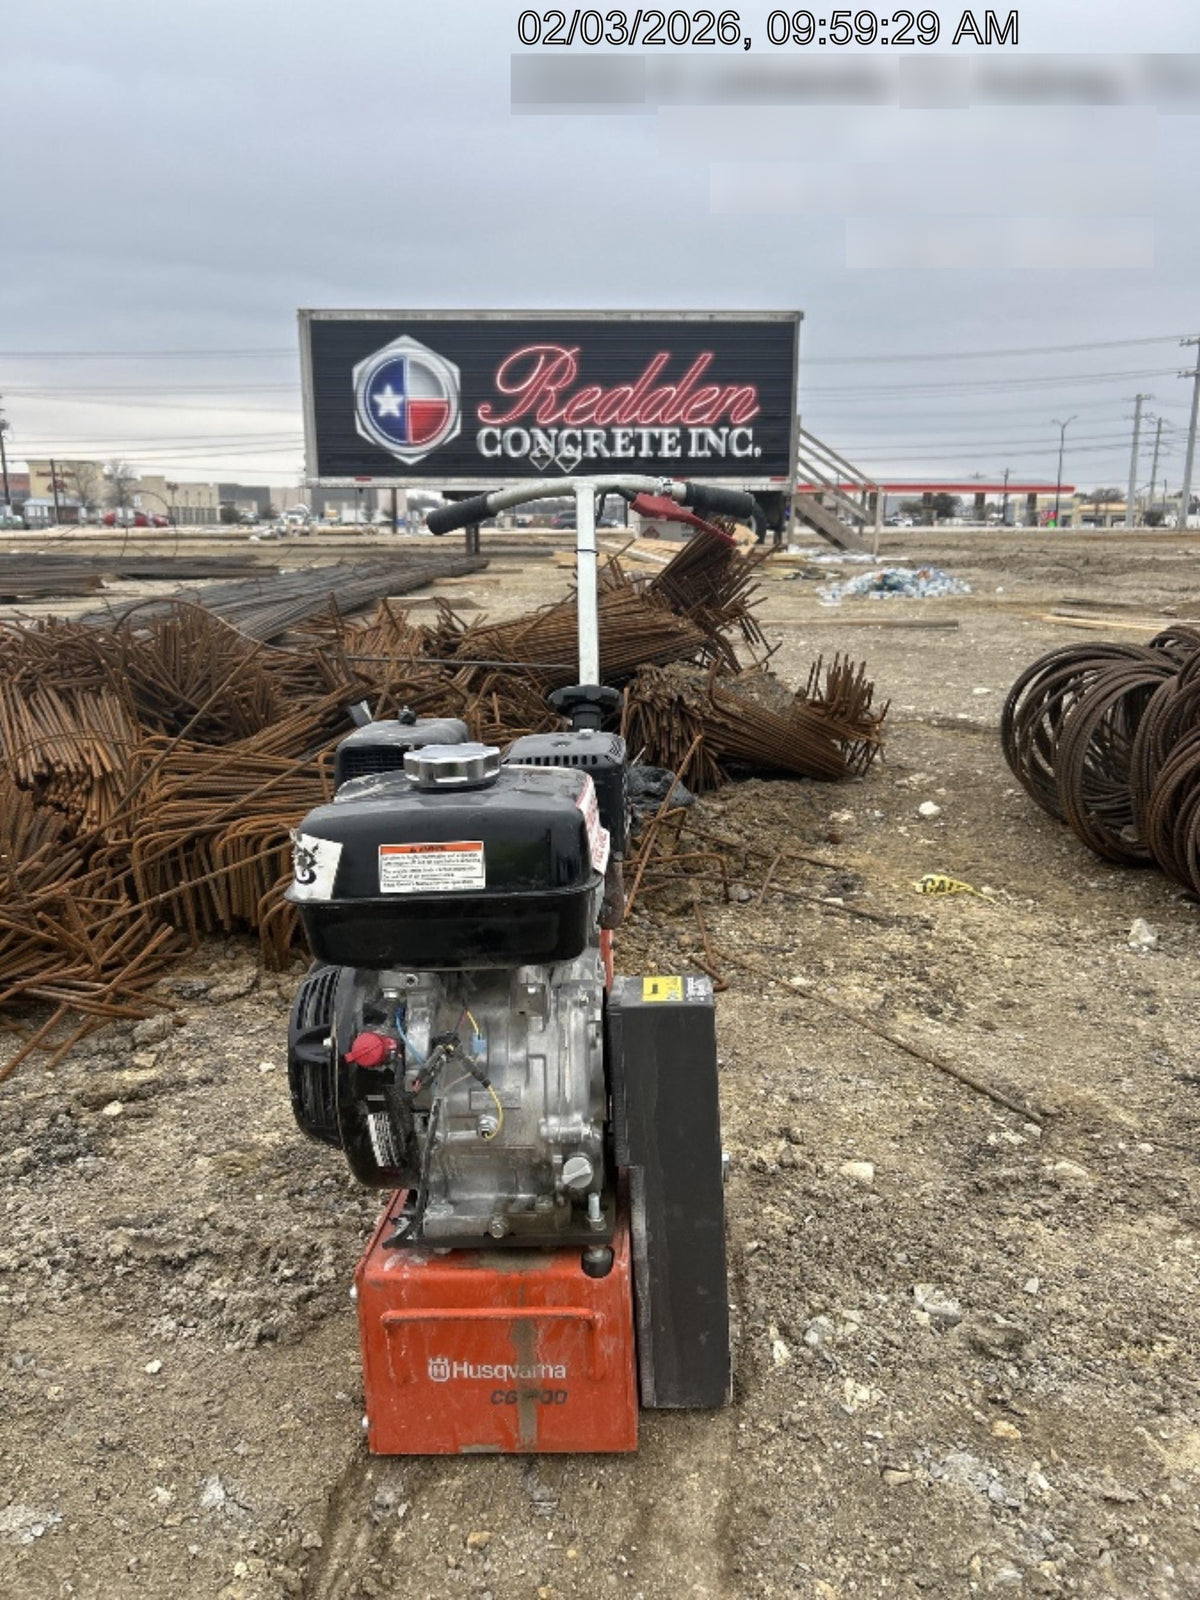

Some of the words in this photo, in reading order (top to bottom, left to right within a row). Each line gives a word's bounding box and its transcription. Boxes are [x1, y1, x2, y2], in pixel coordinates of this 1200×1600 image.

[477, 345, 760, 426] Redden
[476, 427, 681, 459] CONCRETE
[687, 427, 762, 458] INC.
[452, 1361, 567, 1382] Husqvarna
